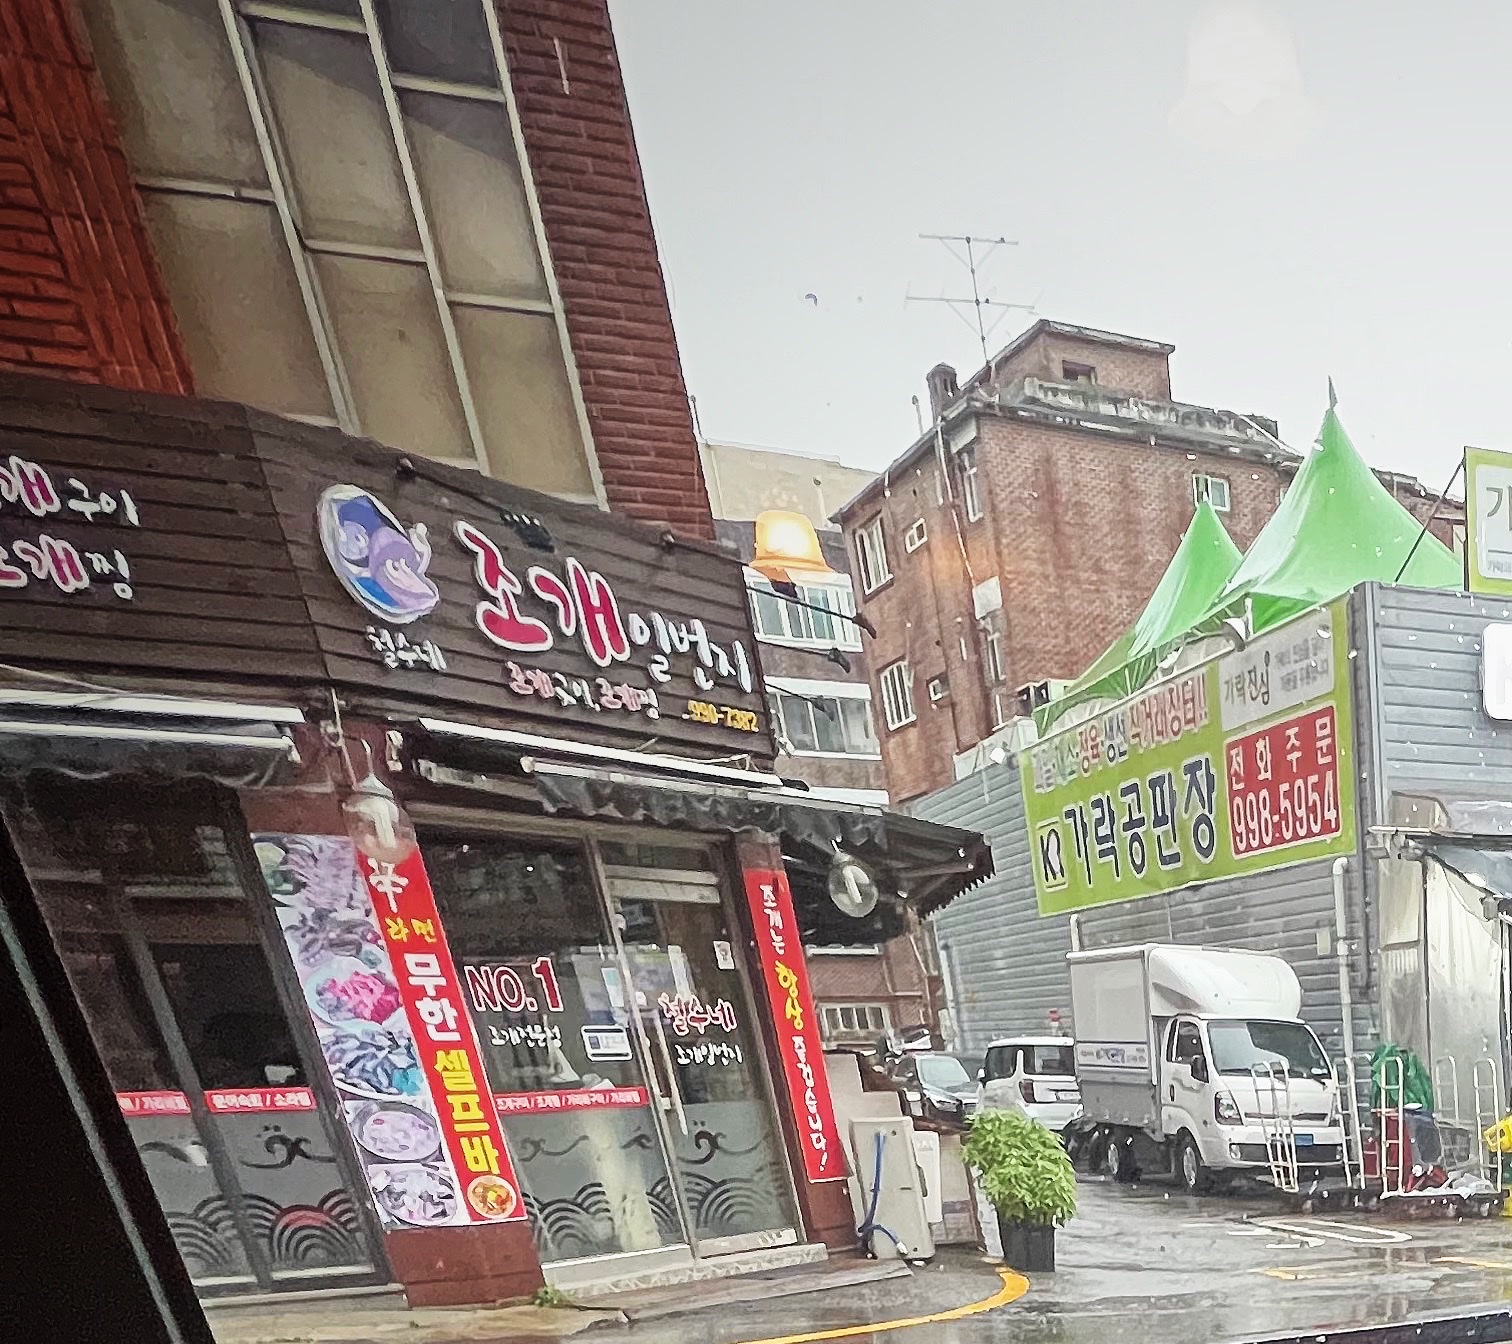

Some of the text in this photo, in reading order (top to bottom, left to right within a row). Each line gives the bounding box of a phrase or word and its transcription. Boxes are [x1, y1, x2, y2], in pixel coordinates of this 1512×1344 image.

[0, 456, 140, 526] 개구이
[1064, 758, 1216, 886] 가락공판장
[1232, 770, 1337, 851] 998-5954
[775, 960, 804, 1031] 항상
[403, 953, 461, 1042] 무한
[434, 1050, 500, 1175] 셀프바
